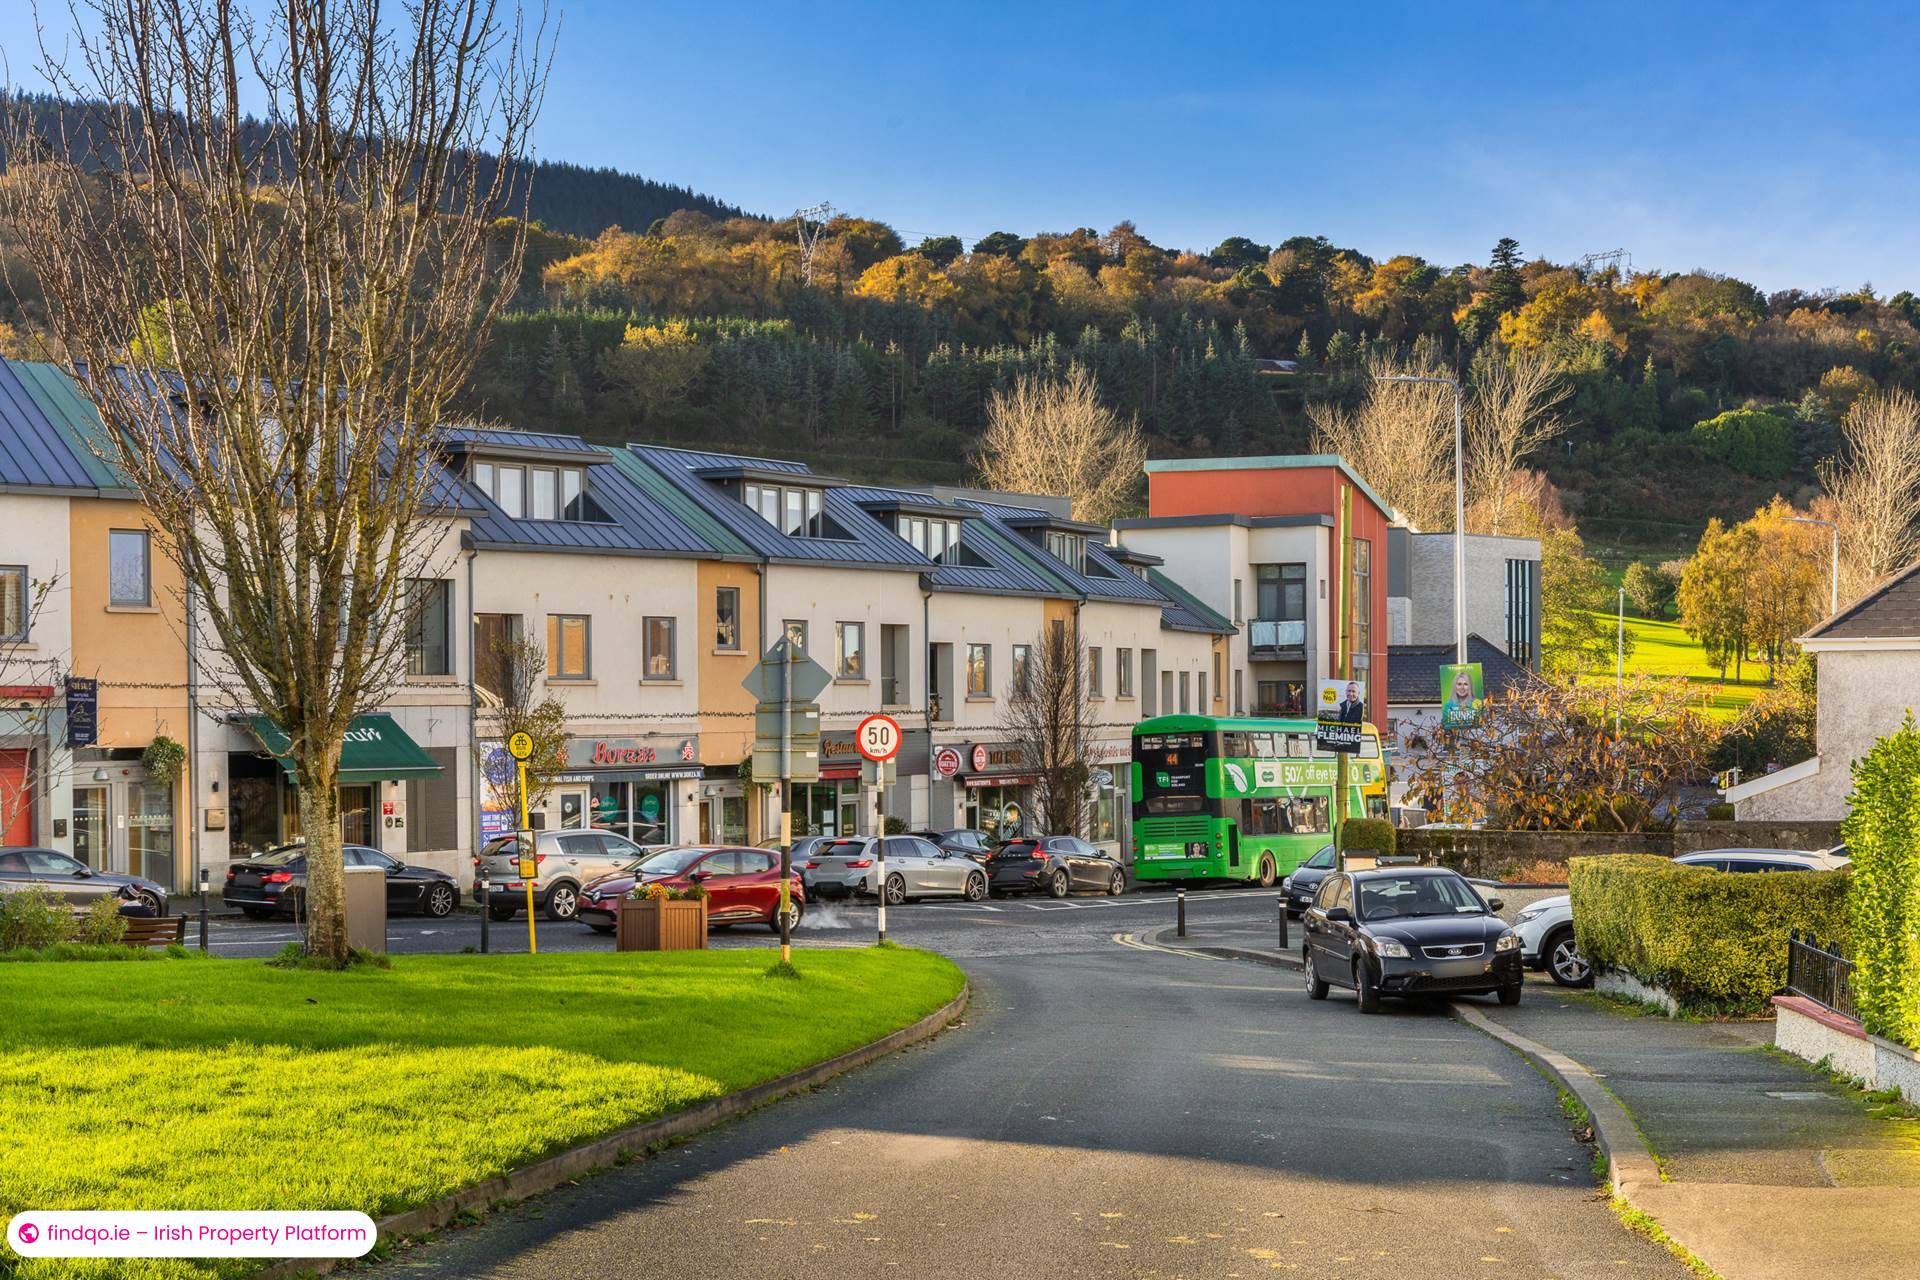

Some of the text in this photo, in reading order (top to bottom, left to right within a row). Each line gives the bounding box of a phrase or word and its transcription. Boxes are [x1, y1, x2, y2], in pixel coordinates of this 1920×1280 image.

[1317, 725, 1360, 734] MICHAEL
[868, 727, 889, 745] 50
[1317, 732, 1361, 742] FLEMING
[1167, 753, 1178, 765] 44
[1285, 766, 1303, 783] 50%
[1306, 766, 1315, 780] off
[1316, 769, 1328, 782] eye
